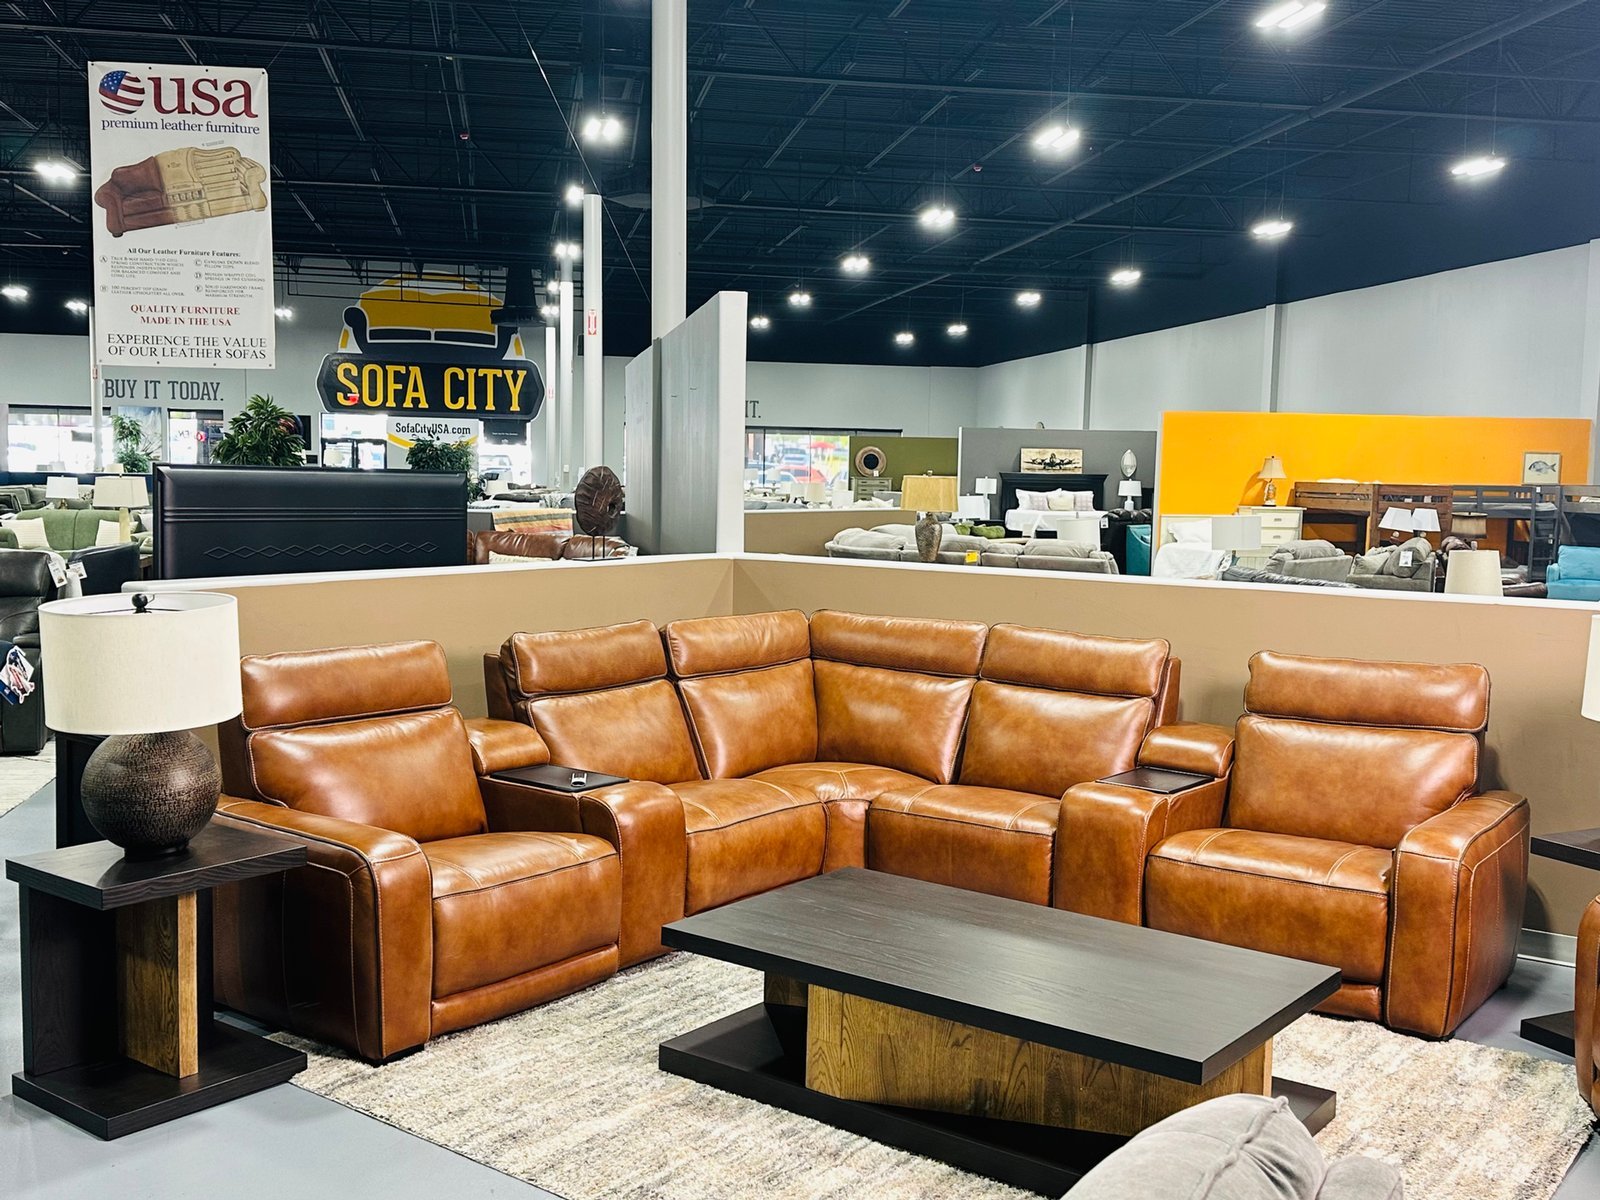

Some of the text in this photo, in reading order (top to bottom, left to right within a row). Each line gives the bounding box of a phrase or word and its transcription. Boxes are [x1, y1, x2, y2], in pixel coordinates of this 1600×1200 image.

[147, 76, 259, 118] usa
[101, 118, 260, 134] premium leather furniture
[130, 304, 240, 315] QUALITY FURNITURE
[140, 316, 231, 326] MADE IN THE USA
[108, 333, 267, 348] EXPERIENCE THE VALUE
[108, 345, 266, 360] OF OUR LEATHER SOFAS
[104, 379, 224, 401] BUY IT TODAY.
[336, 362, 527, 411] SOFA CITY
[395, 422, 471, 435] SofaCityUSA.com
